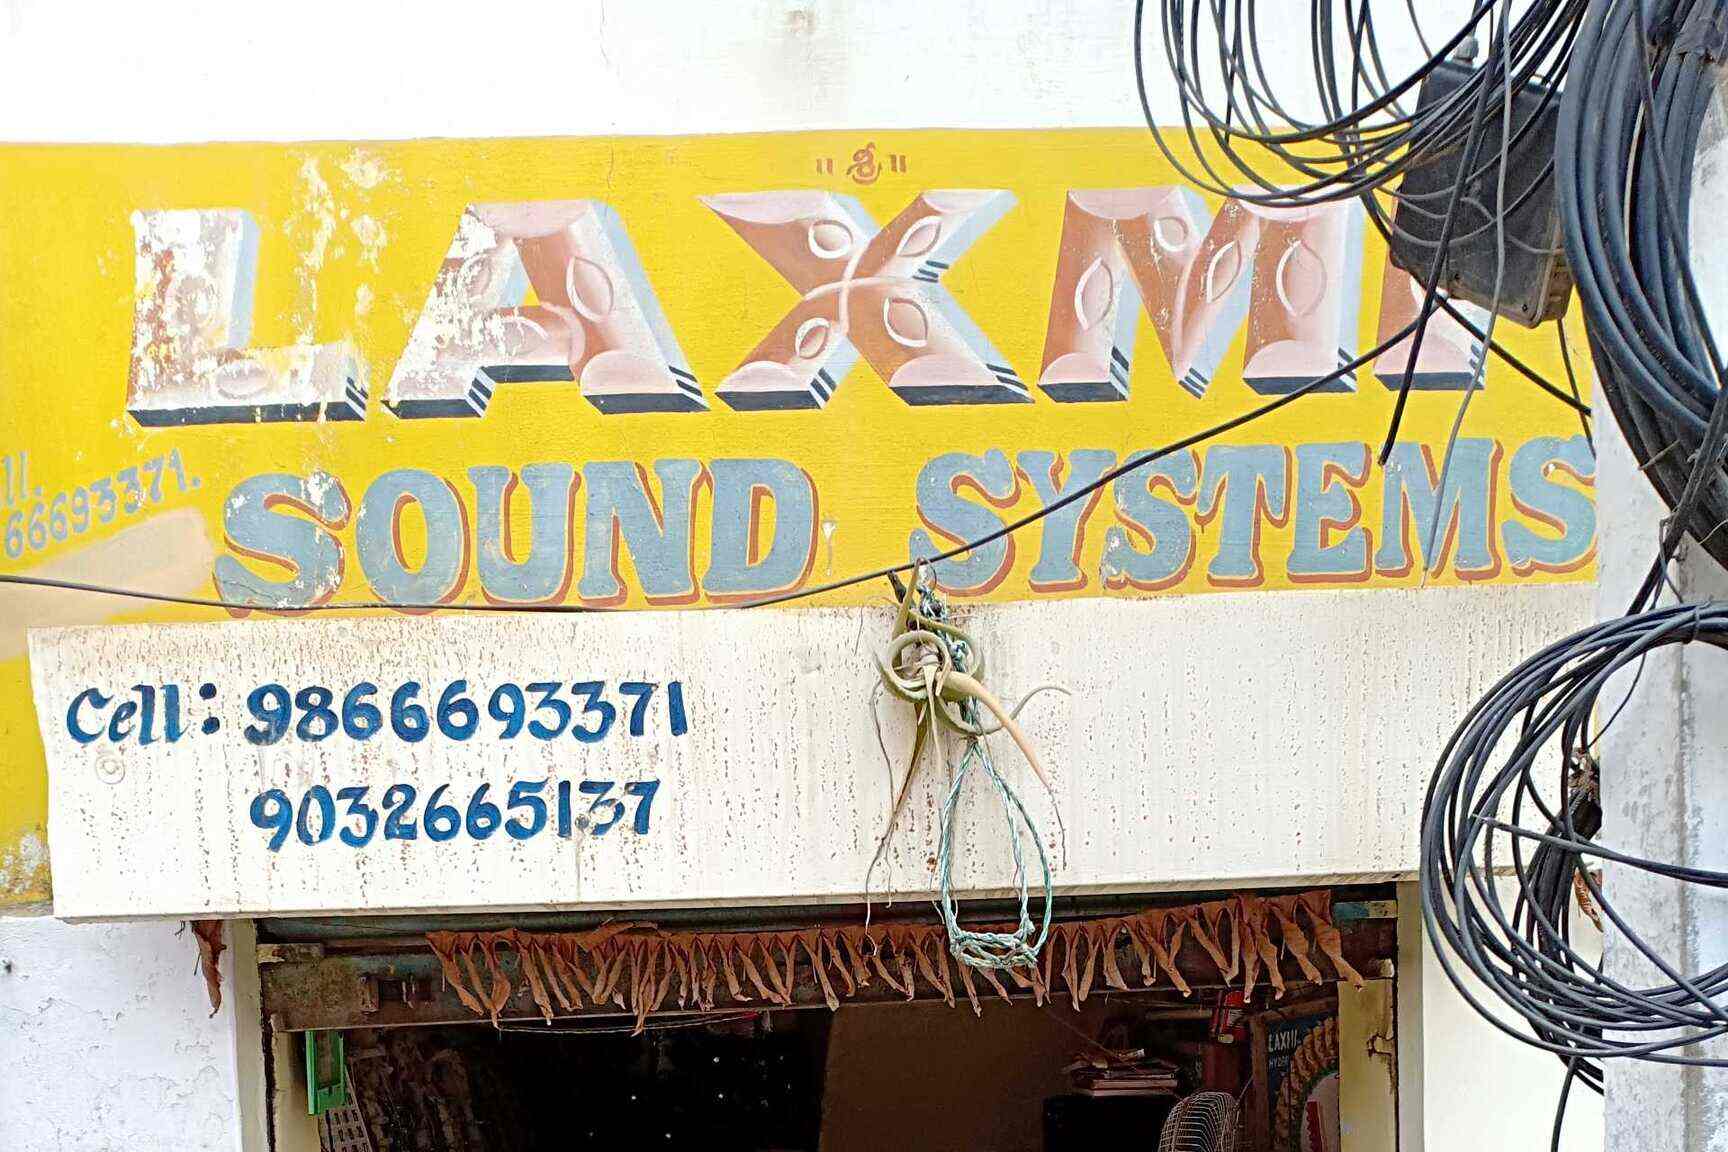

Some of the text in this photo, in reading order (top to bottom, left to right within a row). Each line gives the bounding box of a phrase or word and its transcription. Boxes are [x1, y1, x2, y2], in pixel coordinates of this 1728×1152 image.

[213, 435, 1598, 617] SOUND SYSTEMS
[243, 679, 689, 746] 9866693371
[249, 778, 661, 854] 9032665137
